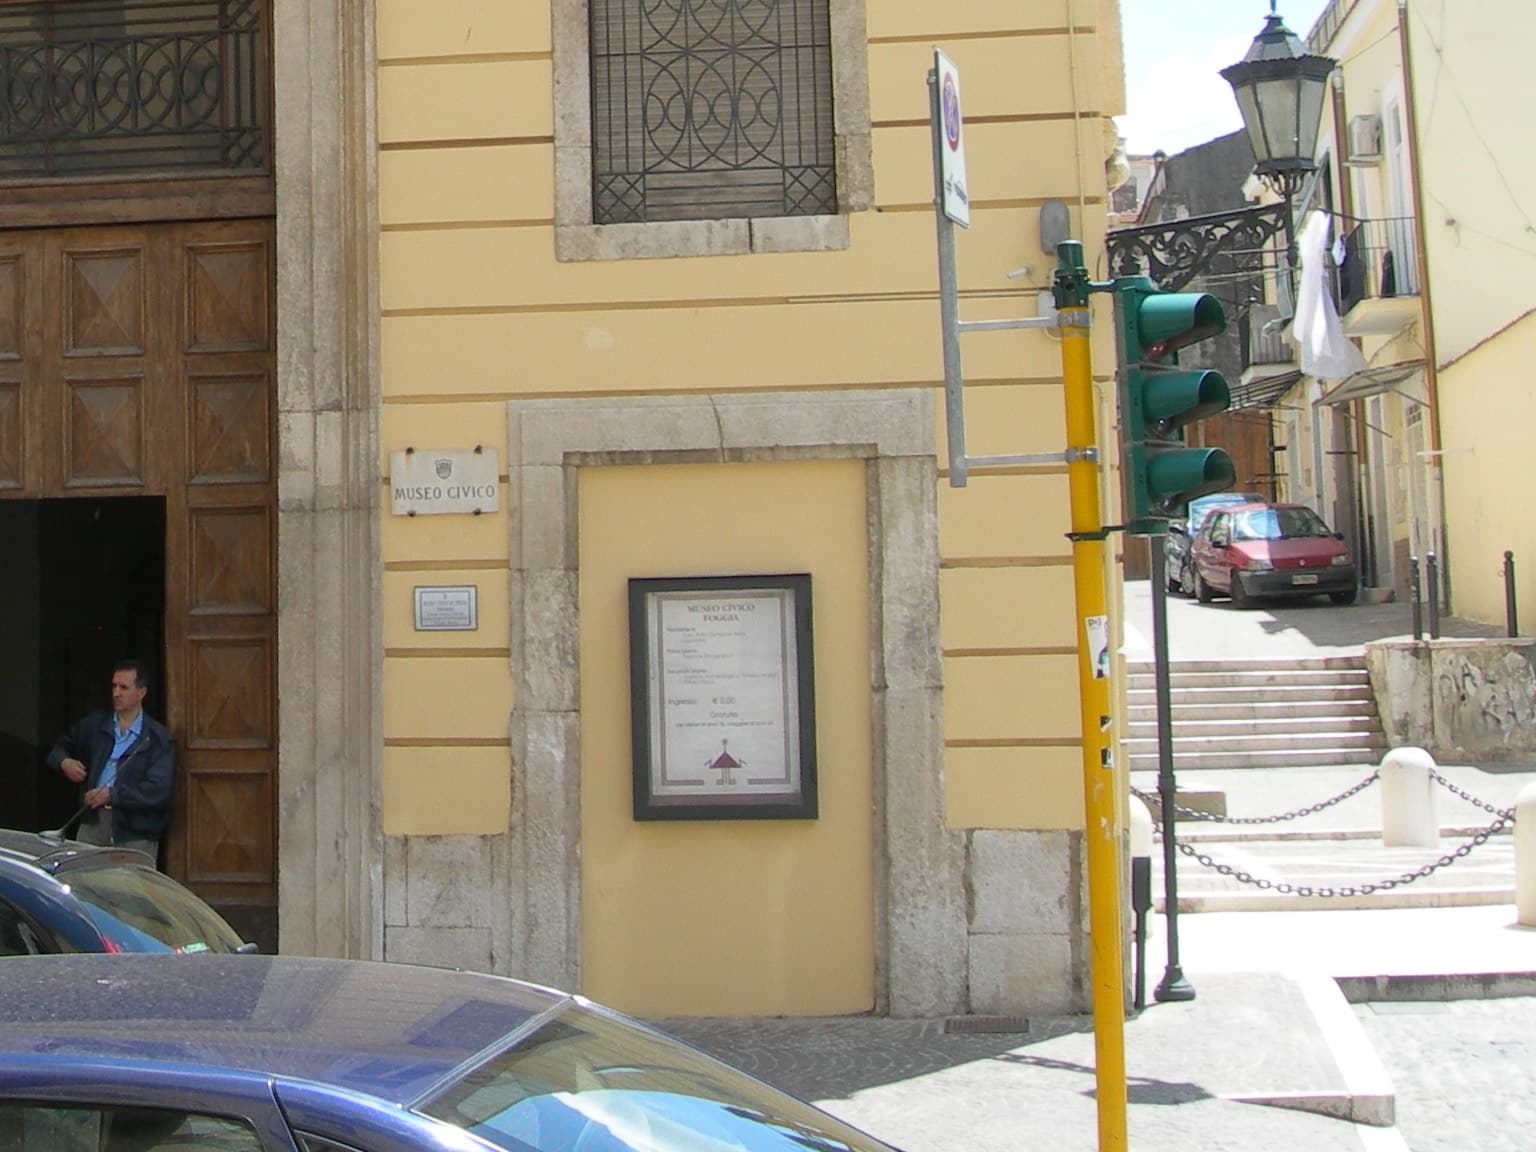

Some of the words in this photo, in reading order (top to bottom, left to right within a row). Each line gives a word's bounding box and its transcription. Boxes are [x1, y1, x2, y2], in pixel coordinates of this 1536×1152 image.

[394, 487, 442, 502] MUSEO
[447, 485, 495, 500] CIVICO
[687, 605, 720, 613] MUSEO
[722, 604, 755, 612] CIVICO
[704, 614, 739, 622] FOGGIA
